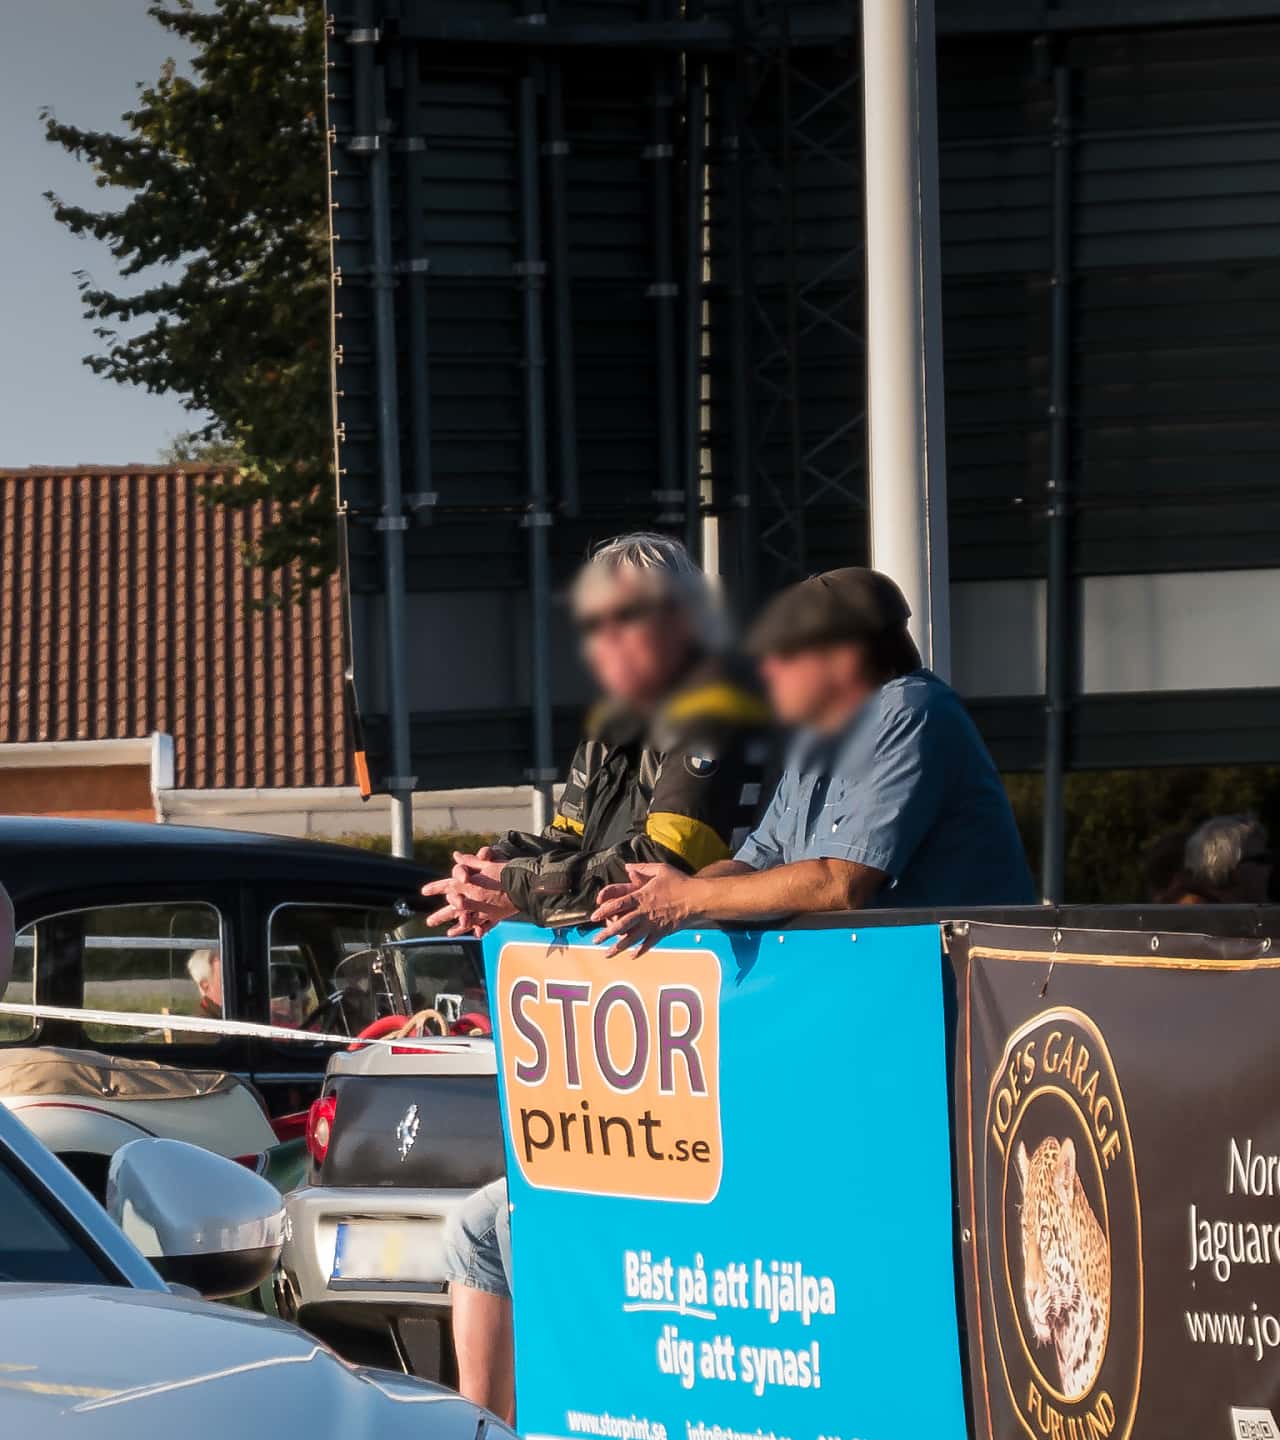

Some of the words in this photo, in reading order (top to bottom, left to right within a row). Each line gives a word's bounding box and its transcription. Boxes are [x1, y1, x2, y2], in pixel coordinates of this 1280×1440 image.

[510, 977, 708, 1095] STOR
[520, 1100, 710, 1163] print.se
[992, 1041, 1036, 1160] JOE'S
[1043, 1031, 1121, 1170] GARAGE
[1229, 1137, 1280, 1196] Nor
[625, 1251, 674, 1301] Bäst
[679, 1252, 708, 1315] på
[713, 1263, 749, 1308] att
[755, 1259, 836, 1325] hjälpa
[658, 1325, 694, 1389] dig
[700, 1336, 736, 1381] att
[740, 1341, 821, 1396] synas!
